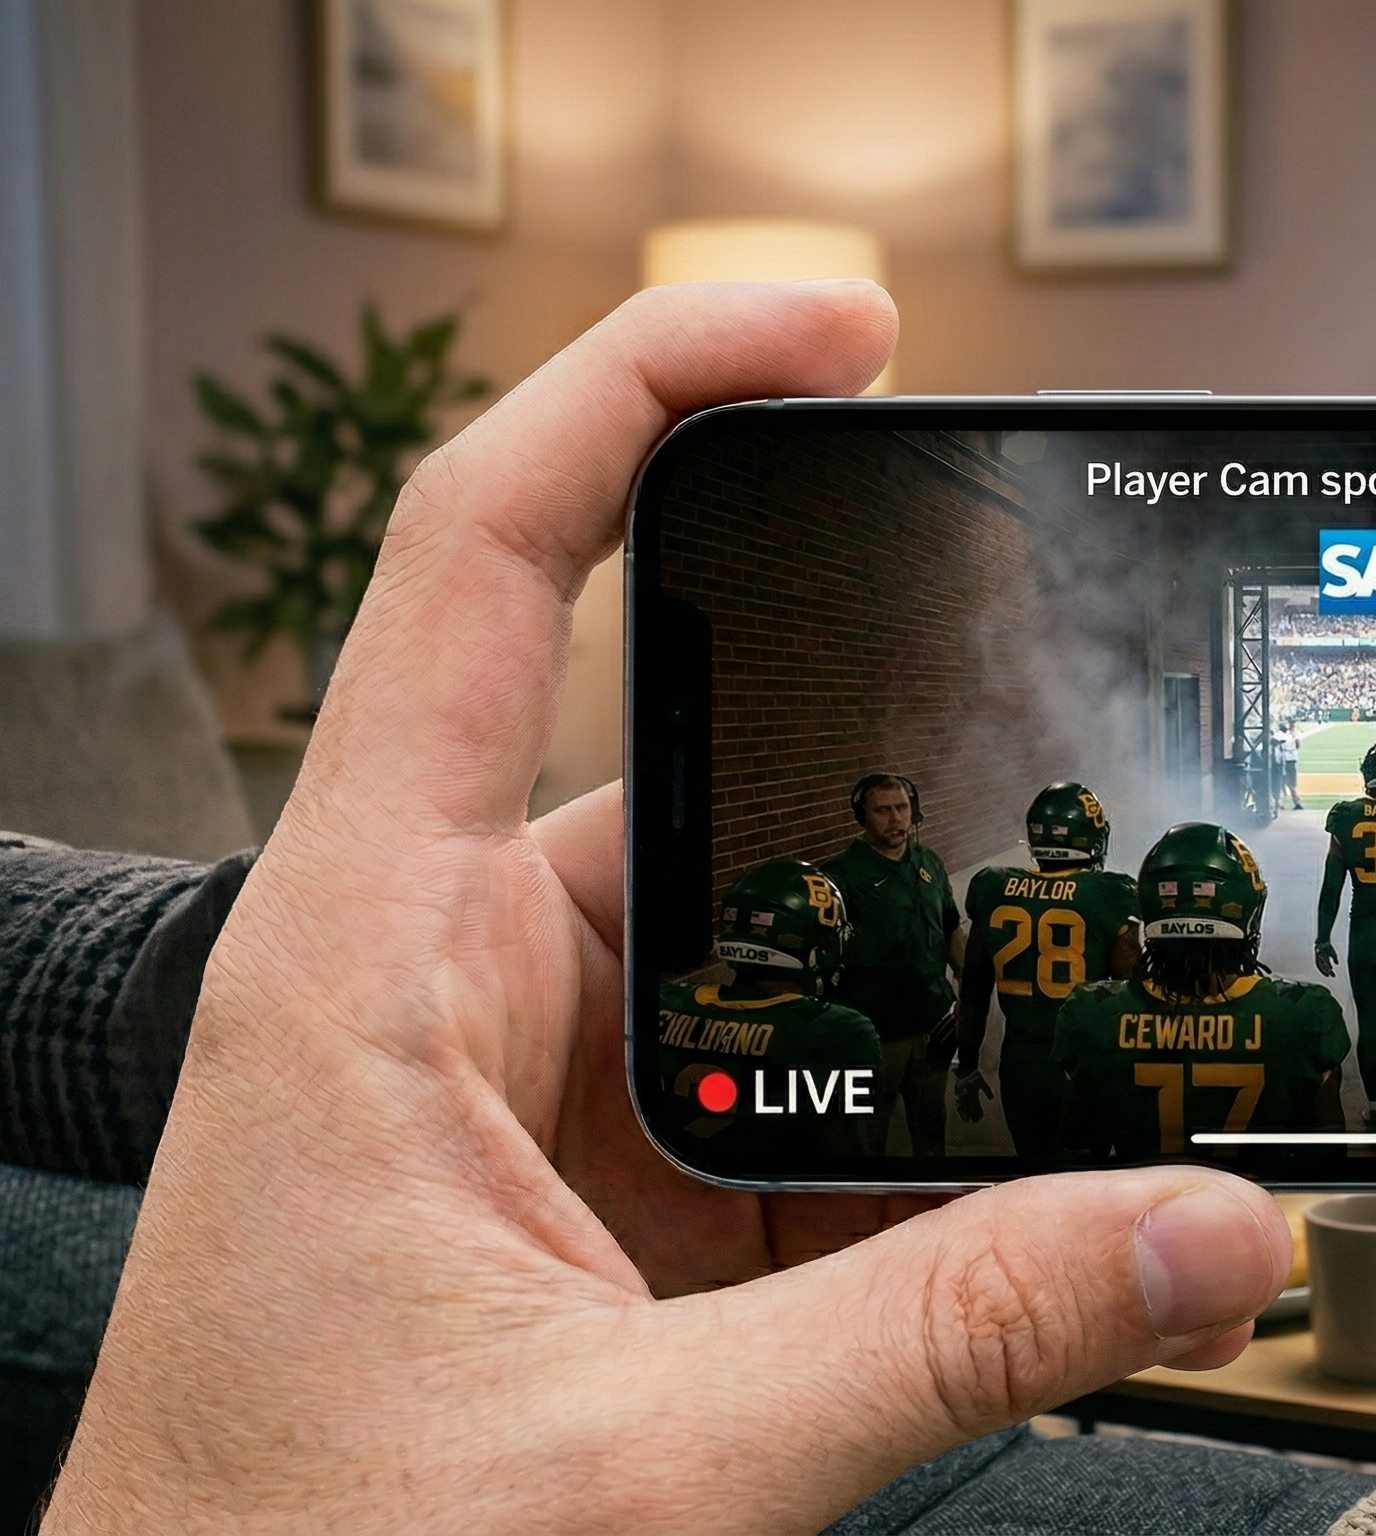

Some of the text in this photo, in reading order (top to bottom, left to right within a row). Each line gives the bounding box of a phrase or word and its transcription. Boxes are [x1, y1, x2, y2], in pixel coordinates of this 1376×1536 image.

[1086, 462, 1207, 505] Player
[1220, 462, 1308, 497] Cam
[1004, 878, 1078, 902] BAYLOR
[989, 906, 1087, 1000] 28
[1119, 1013, 1262, 1050] CEWARD J
[754, 1069, 875, 1115] LIVE
[1134, 1063, 1266, 1155] 17
